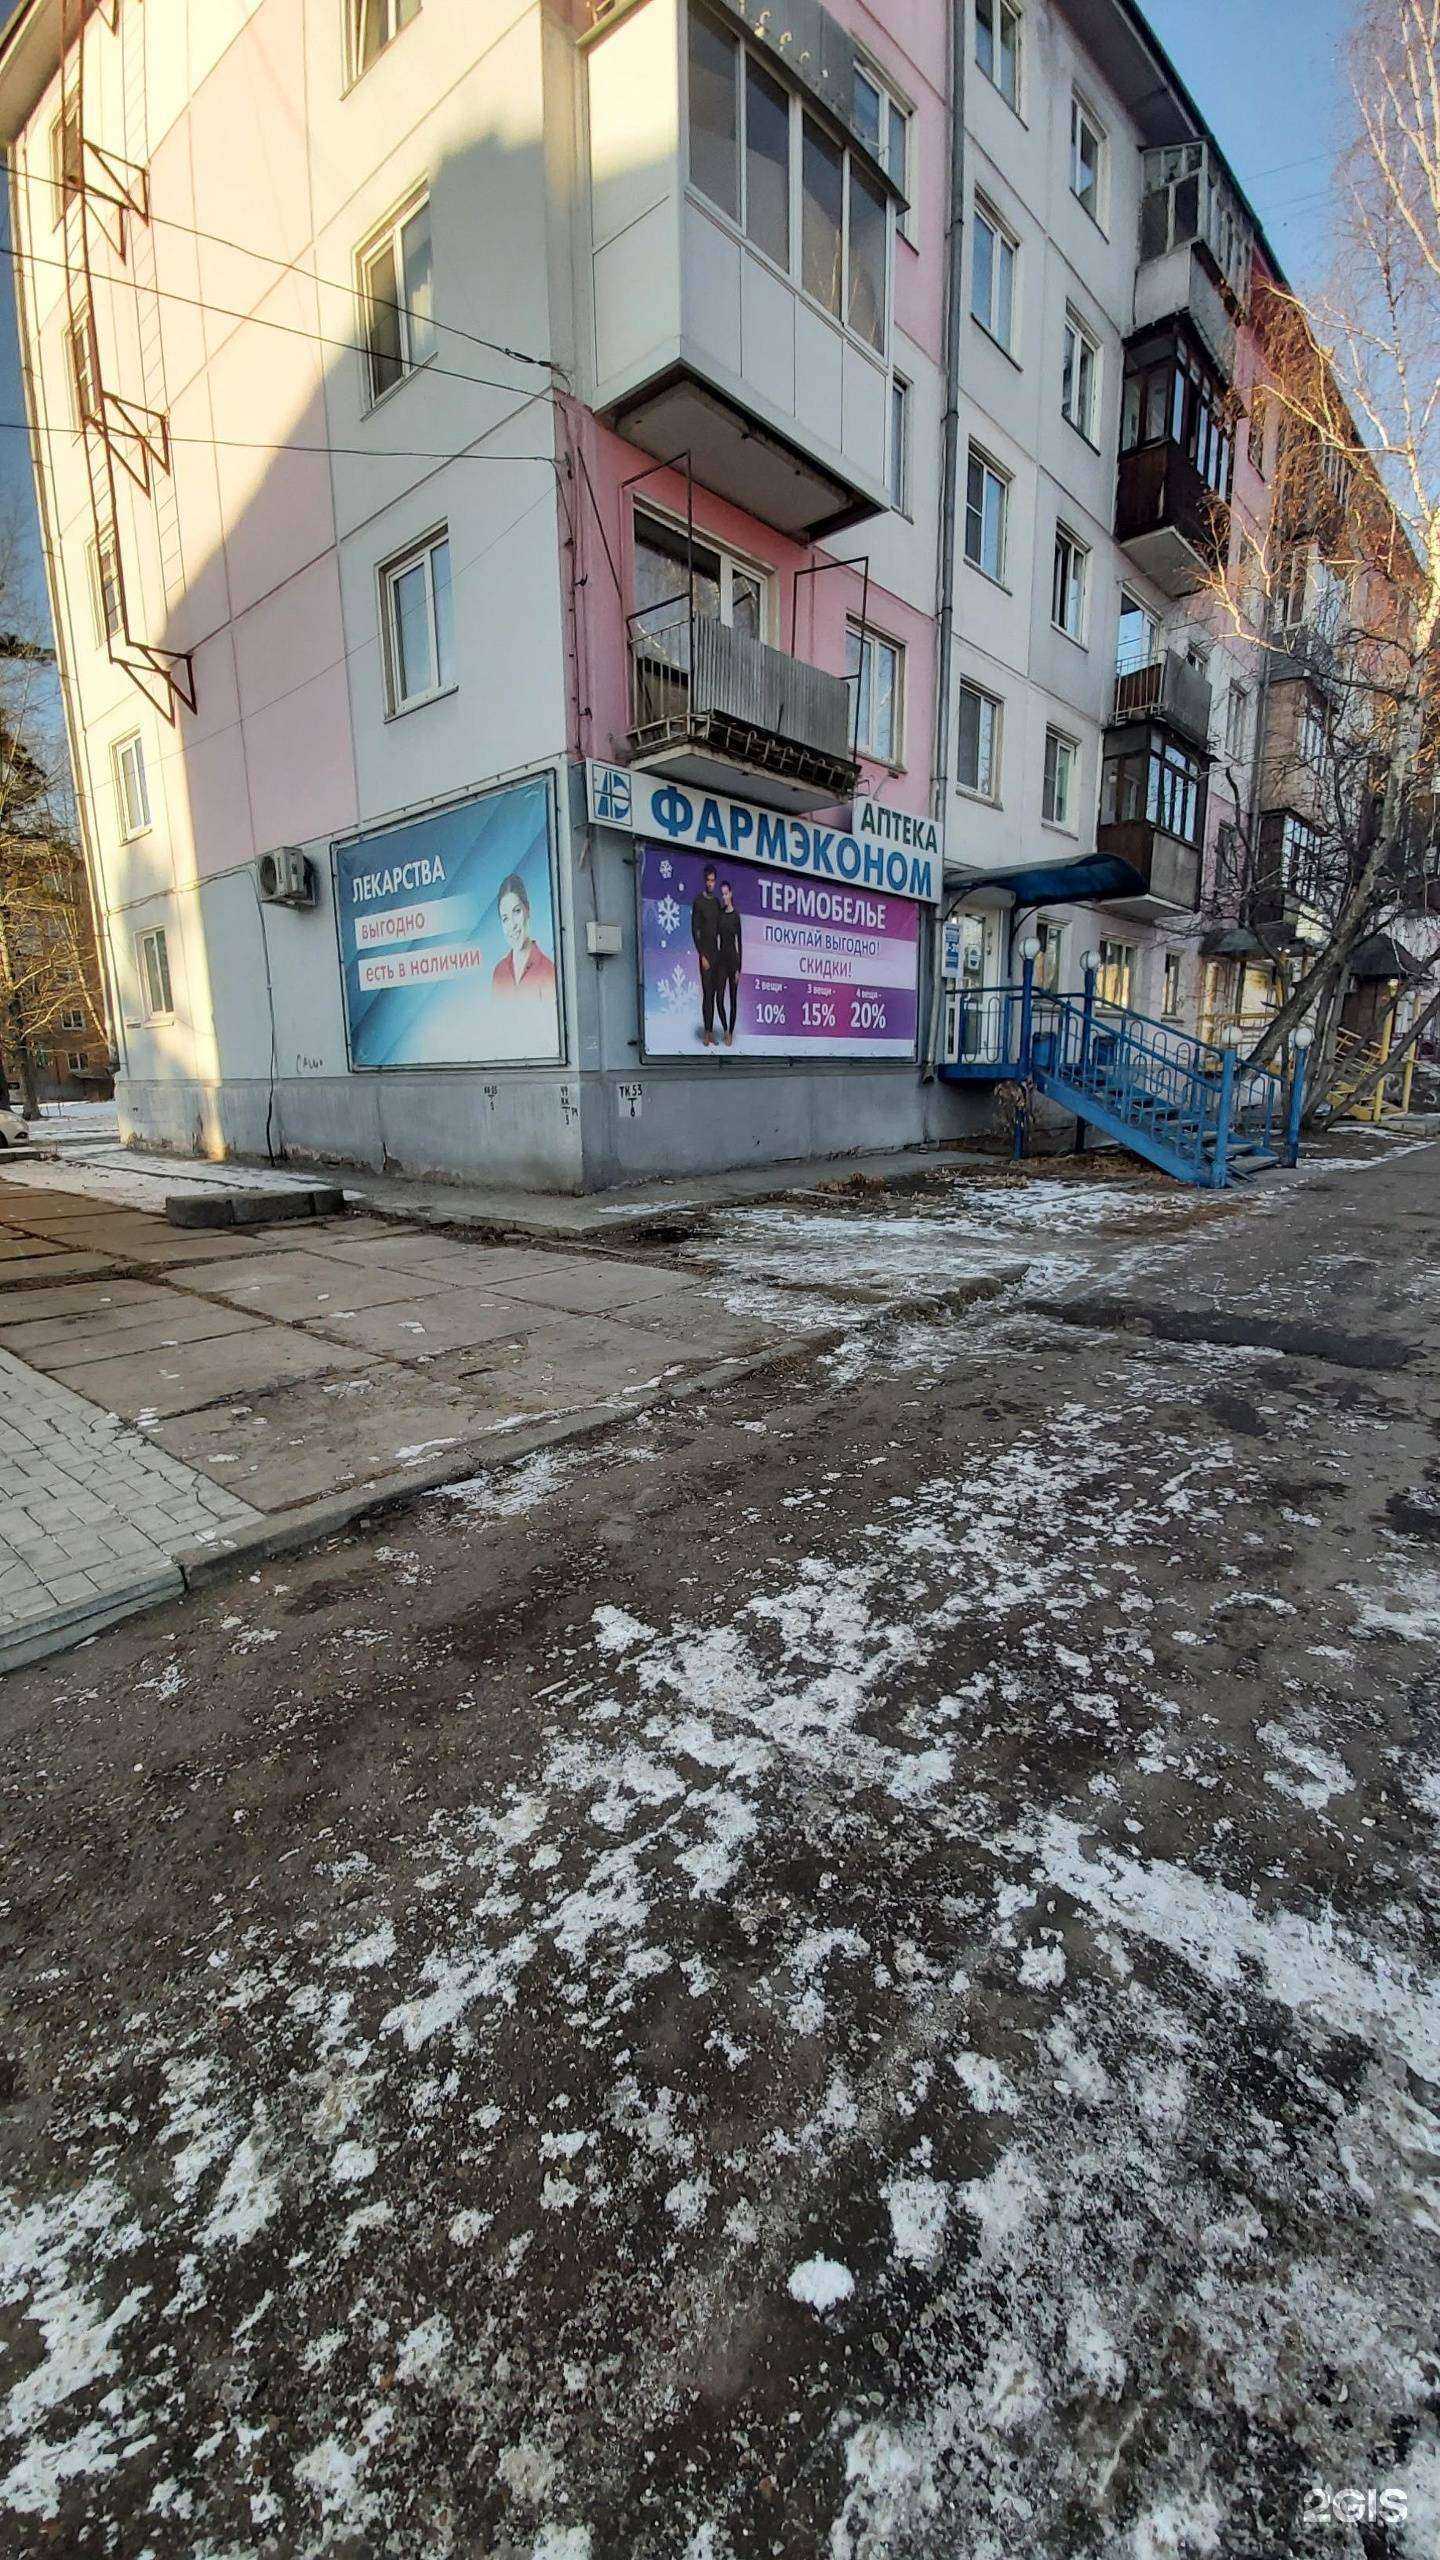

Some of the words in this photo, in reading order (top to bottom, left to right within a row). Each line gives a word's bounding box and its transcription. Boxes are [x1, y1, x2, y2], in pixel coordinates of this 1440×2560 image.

[860, 803, 938, 853] АПТЕКА
[651, 786, 933, 897] ФАРМЭКОНОМ
[353, 855, 446, 903] ЛЕКАРСТВА
[758, 879, 886, 929] ТЕРМОБЕЛЬЕ
[765, 926, 822, 948] ПОКУПАЙ
[825, 935, 880, 957] ВЫГОДНО!
[800, 957, 852, 978] СКИДКИ!
[755, 979, 760, 990] 2
[762, 981, 783, 993] вещи
[807, 984, 813, 995] 3
[814, 986, 832, 997] вещи
[856, 988, 861, 998] 4
[755, 1003, 786, 1024] 10%
[802, 1003, 836, 1027] 15%
[850, 1002, 887, 1029] 20%
[632, 1084, 643, 1096] 53
